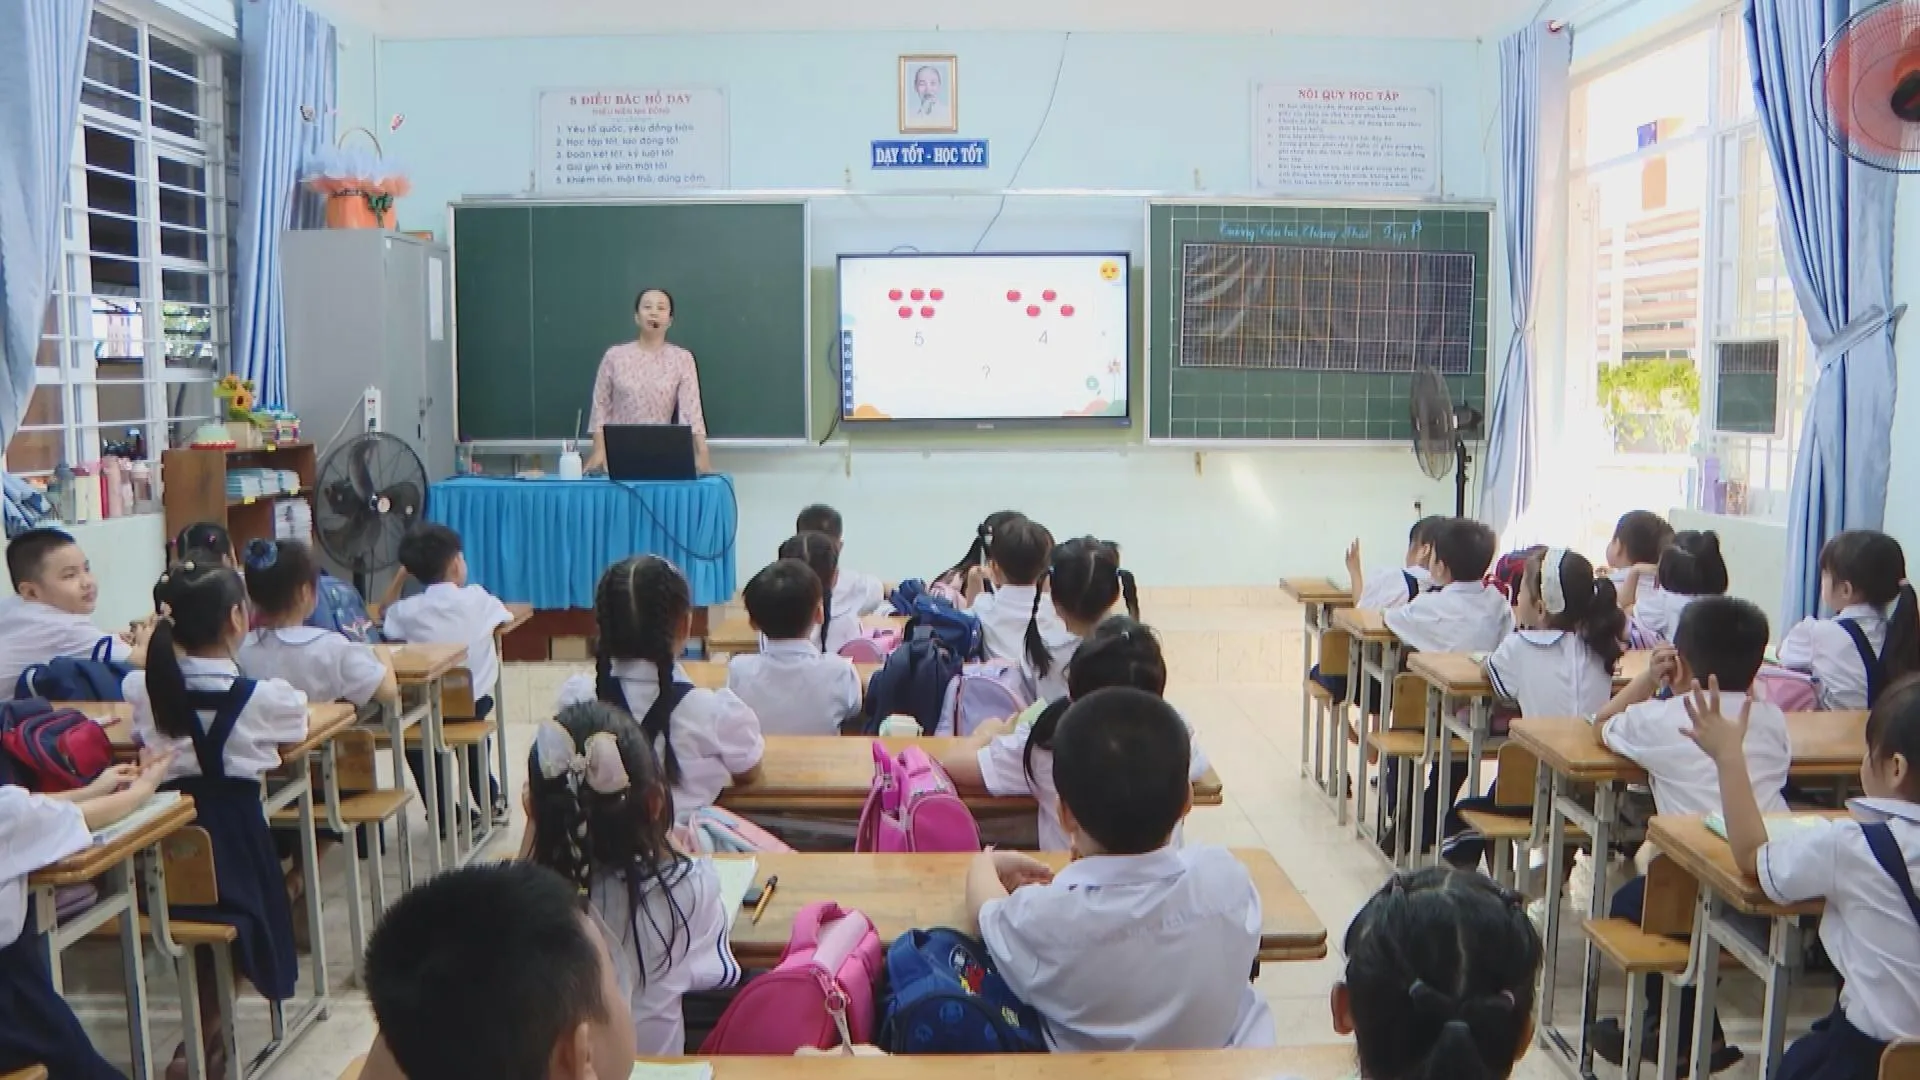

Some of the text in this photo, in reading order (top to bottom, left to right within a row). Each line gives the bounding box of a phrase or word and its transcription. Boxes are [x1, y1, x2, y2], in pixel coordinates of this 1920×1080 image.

[876, 147, 899, 167] DẠY
[902, 141, 925, 163] TỐT
[934, 147, 958, 166] HỌC
[961, 141, 984, 163] TỐT
[914, 331, 924, 346] 5
[1038, 330, 1048, 345] 4
[982, 365, 991, 379] ?
